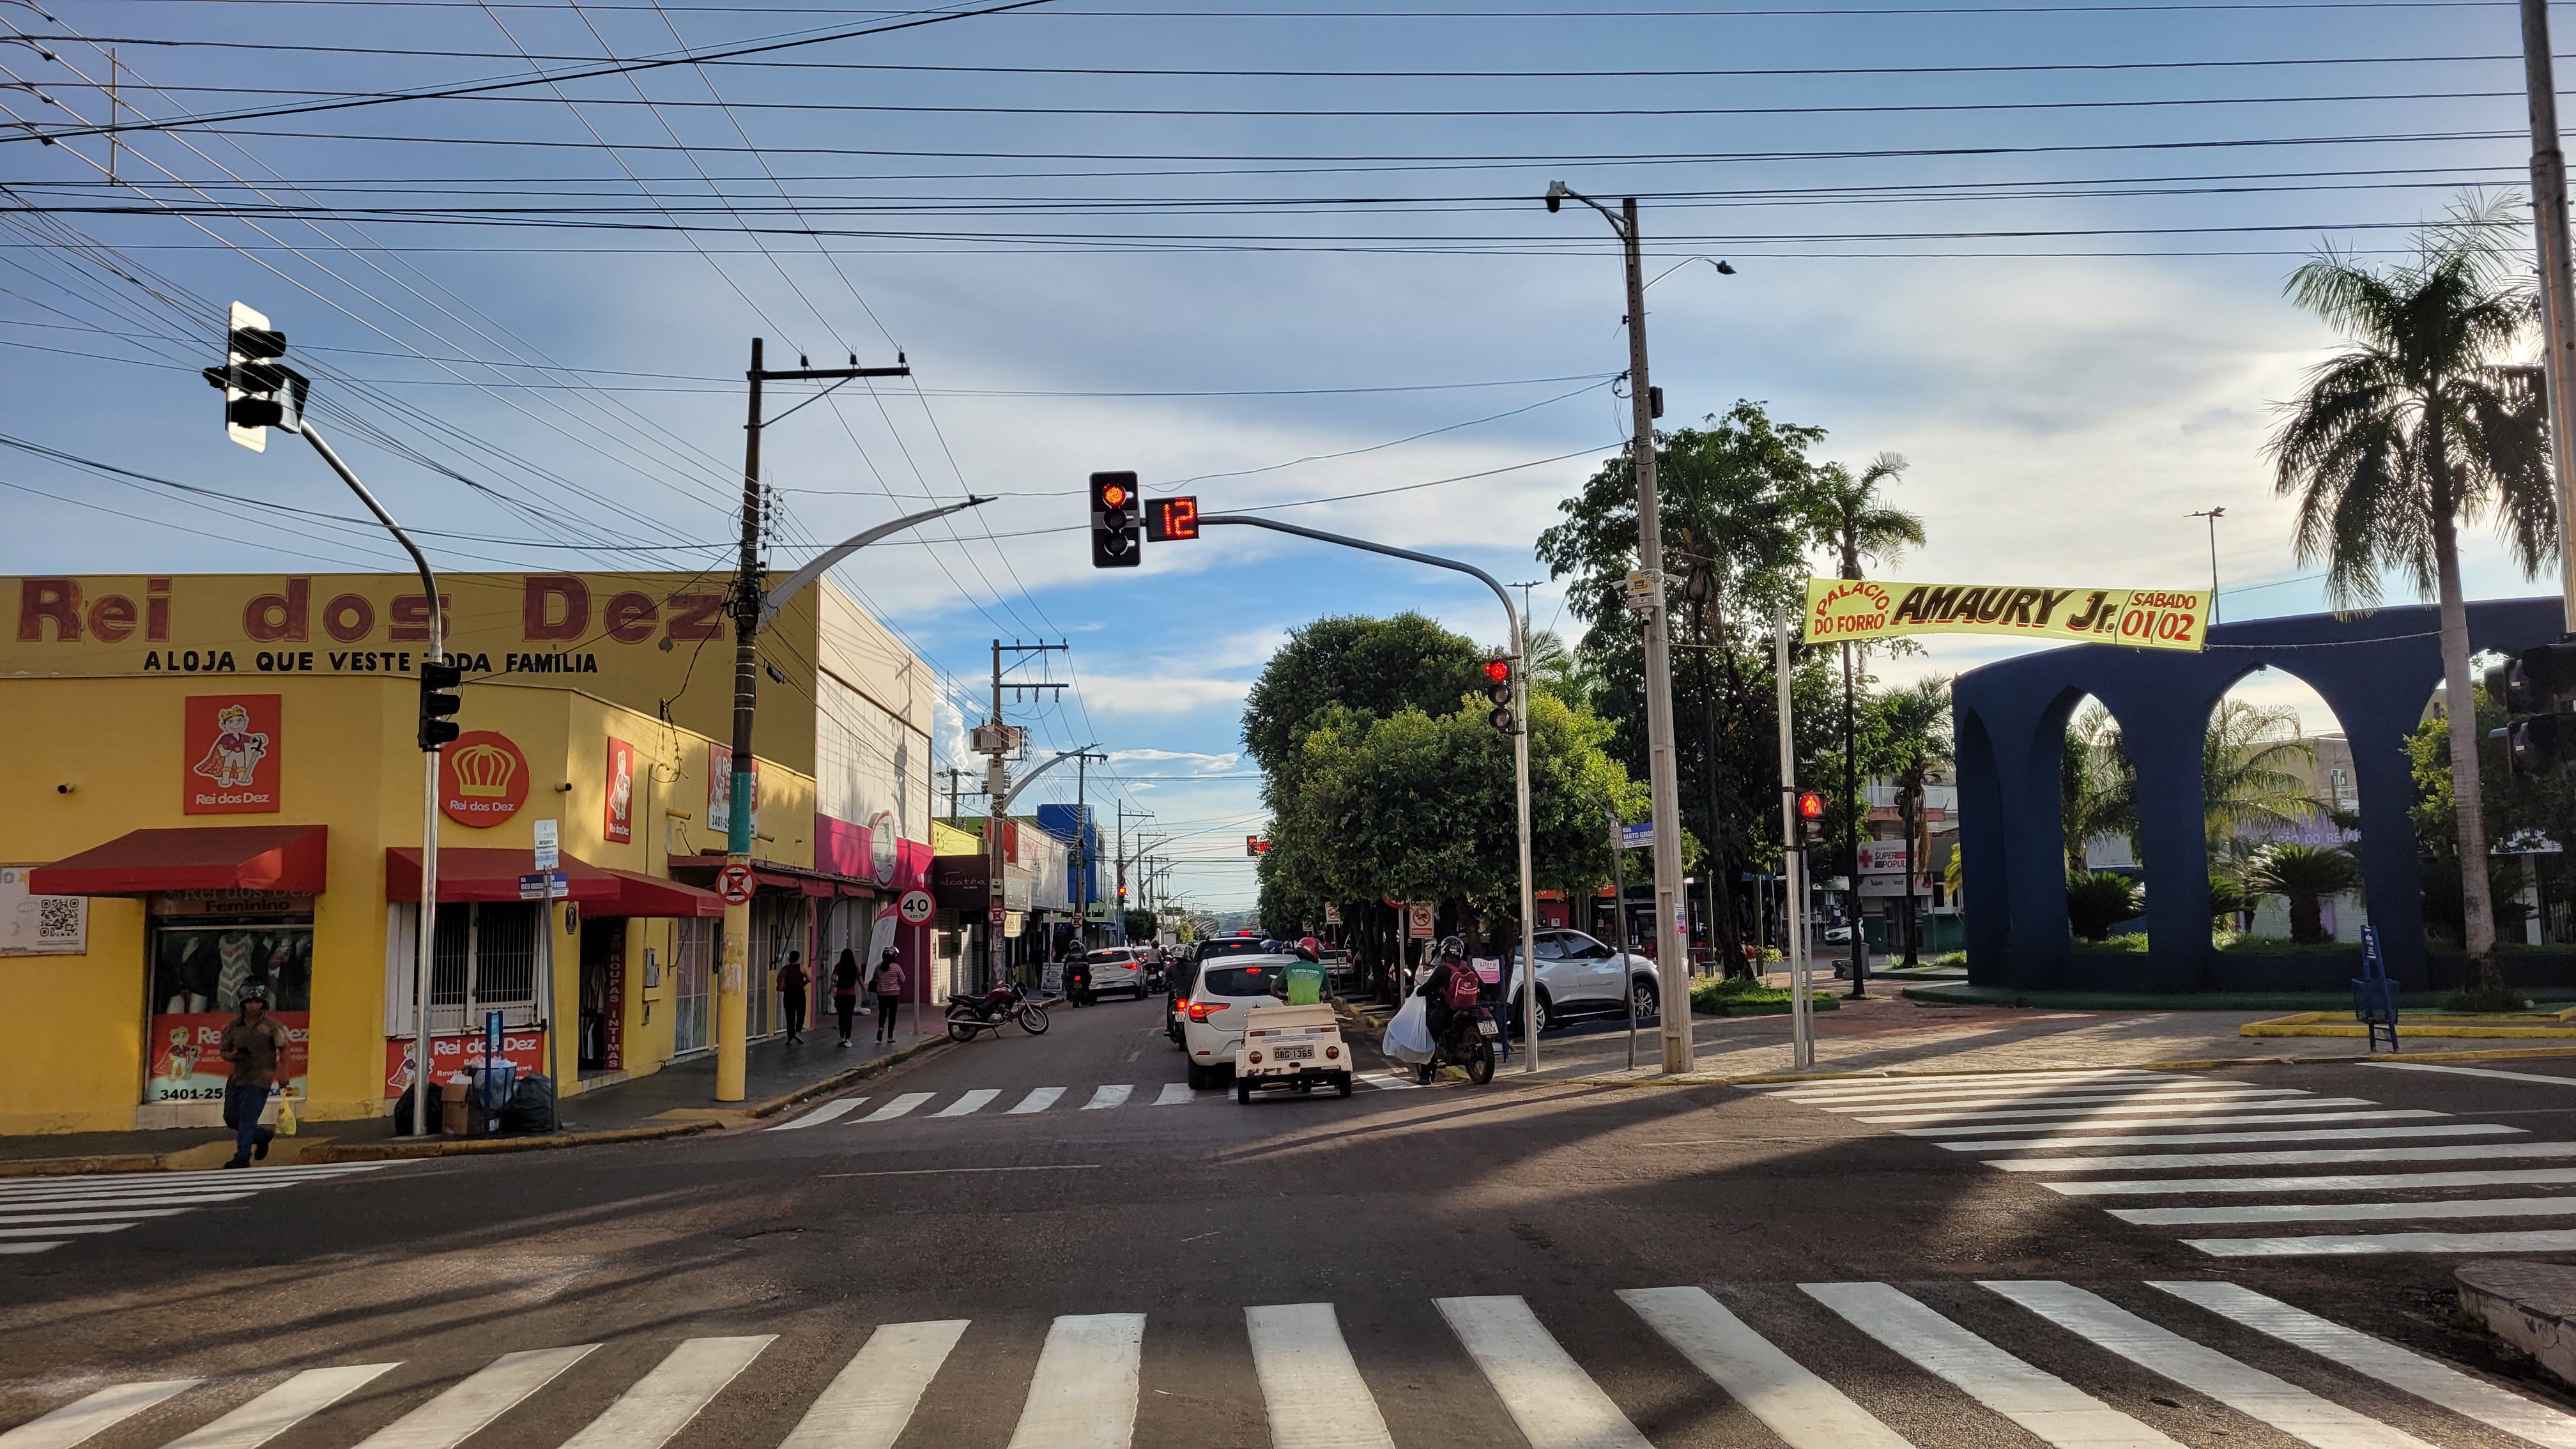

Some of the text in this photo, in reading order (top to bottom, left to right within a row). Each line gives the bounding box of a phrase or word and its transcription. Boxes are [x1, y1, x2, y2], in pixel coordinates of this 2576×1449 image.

[1163, 497, 1194, 535] 12
[17, 574, 725, 644] Rei dos Dez
[2131, 590, 2196, 610] SÁBADO
[1890, 586, 2120, 634] AMAURY Jr.
[1814, 617, 1834, 636] DO
[2121, 609, 2195, 644] 01/02
[256, 652, 313, 671] QUE
[329, 652, 411, 671] VESTE
[506, 653, 598, 673] FAMILIA
[195, 792, 270, 804] Rei dos Dez
[450, 799, 514, 811] Rei dos Dez
[1623, 832, 1639, 840] MATO
[2305, 834, 2320, 844] DO
[206, 901, 290, 912] Feminino
[903, 899, 928, 912] 40
[609, 954, 620, 1002] ROUPAS
[197, 1027, 222, 1044] Re
[608, 1009, 620, 1068] INTIMAS
[434, 1039, 461, 1055] Rei
[504, 1037, 536, 1052] Dez
[160, 1088, 227, 1100] 3401-25
